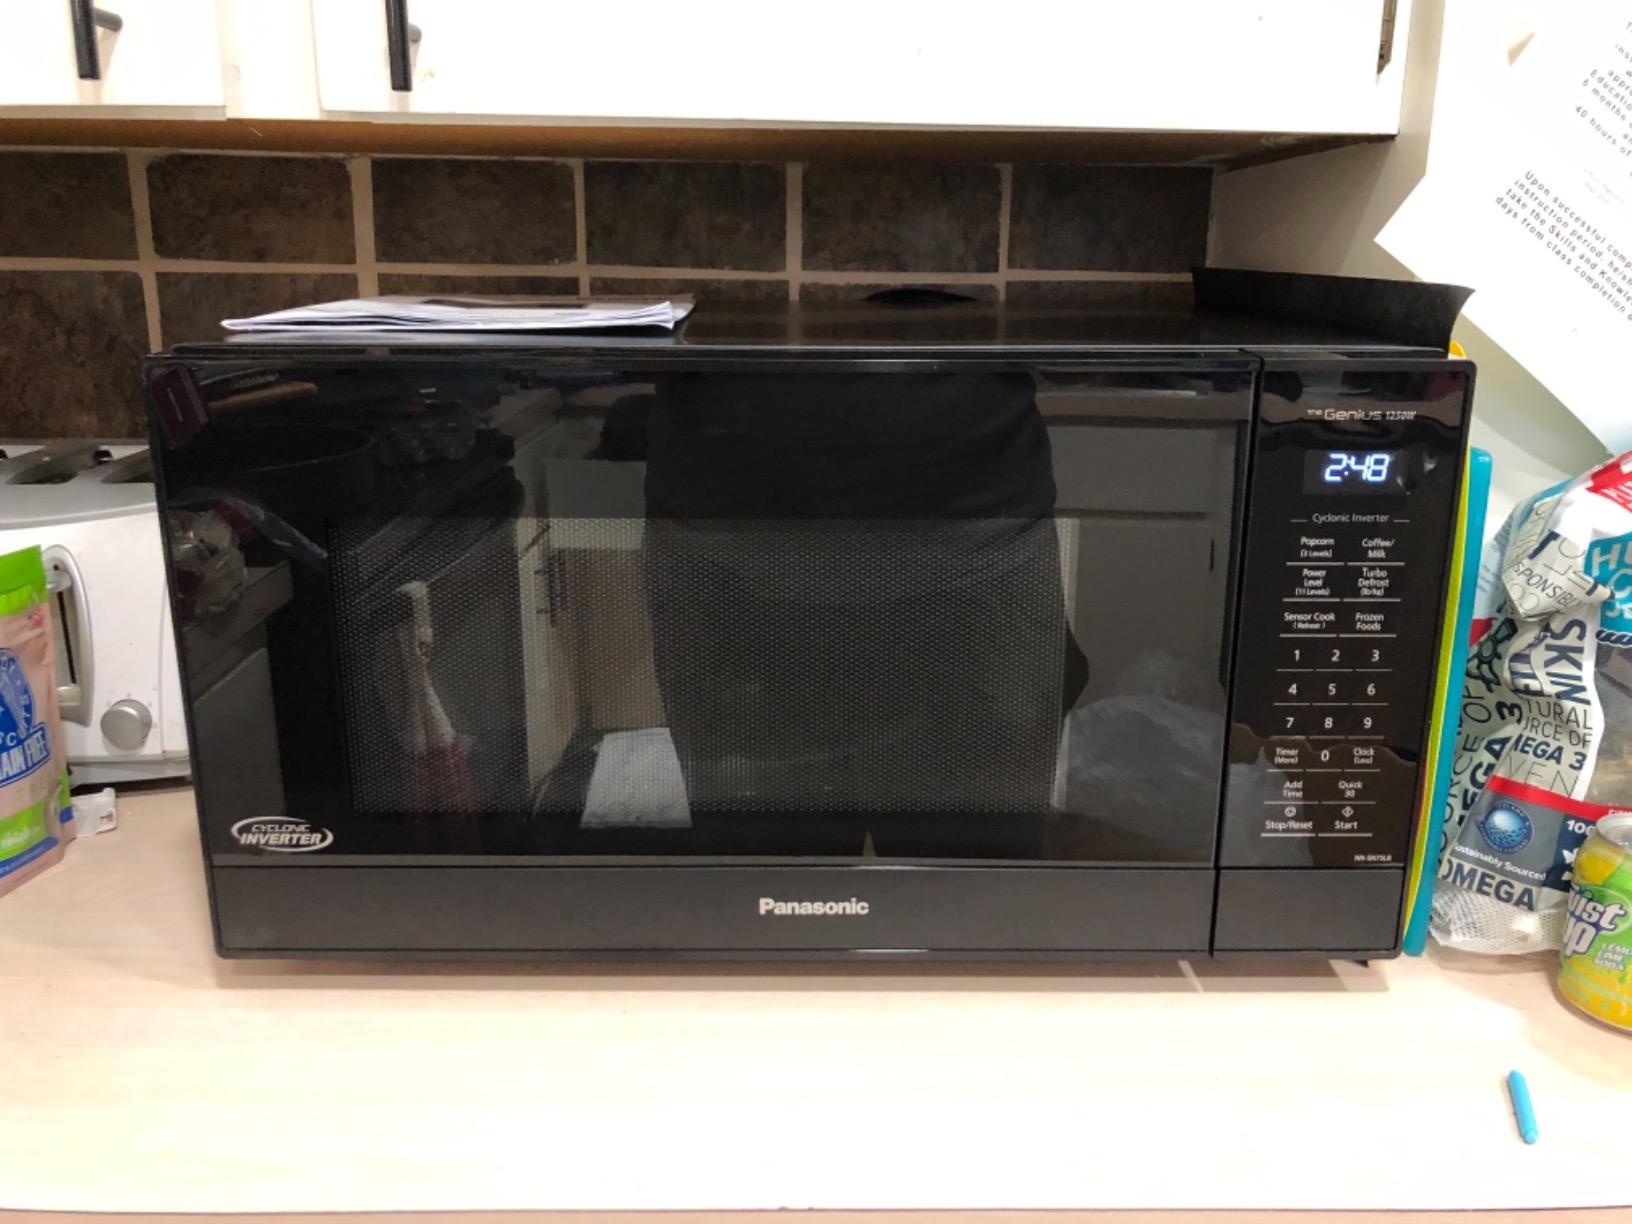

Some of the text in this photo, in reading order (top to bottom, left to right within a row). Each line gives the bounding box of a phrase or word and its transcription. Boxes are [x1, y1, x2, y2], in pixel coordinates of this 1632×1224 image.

[1590, 69, 1632, 111] Educatio
[1592, 88, 1627, 122] months
[1589, 117, 1618, 146] hours
[1514, 178, 1570, 229] instruction
[1525, 170, 1632, 270] Upon successful comp
[1506, 188, 1632, 303] take the Skills and Knowle
[1495, 197, 1626, 313] days from class completion
[1324, 453, 1390, 482] 2:48
[1312, 513, 1389, 524] Cyclonic Inverter
[1300, 536, 1335, 547] Popcorn
[1367, 548, 1386, 558] Milk
[1302, 568, 1327, 578] Power
[1362, 567, 1388, 577] Turbo
[1304, 578, 1323, 587] Level
[1357, 578, 1390, 587] Defrost
[1284, 612, 1336, 621] Sensor Cook
[1355, 612, 1385, 621] Frozen
[1356, 621, 1381, 630] Foods
[1293, 650, 1301, 662] 1
[1331, 650, 1341, 662] 2
[1371, 650, 1380, 662] 3
[1543, 618, 1591, 705] SKIN
[1288, 684, 1298, 695] 4
[1328, 684, 1337, 695] 5
[1366, 684, 1376, 695] 6
[1495, 700, 1523, 725] 3
[1286, 717, 1295, 728] 7
[1324, 717, 1333, 728] 8
[1363, 717, 1373, 728] 9
[1569, 730, 1593, 749] OF
[1275, 747, 1299, 756] Timer
[1321, 750, 1330, 762] 0
[1353, 747, 1375, 756] Clock
[1568, 751, 1588, 771] 3
[1284, 781, 1303, 789] Add
[1338, 781, 1363, 790] Quick
[1283, 789, 1304, 798] Time
[251, 824, 312, 832] CYCLONIC
[1265, 820, 1313, 831] Stop/Reset
[1334, 820, 1358, 830] Start
[240, 832, 323, 846] INVERTER
[1455, 844, 1547, 880] ustainably Sourced
[759, 897, 870, 915] Panasonic
